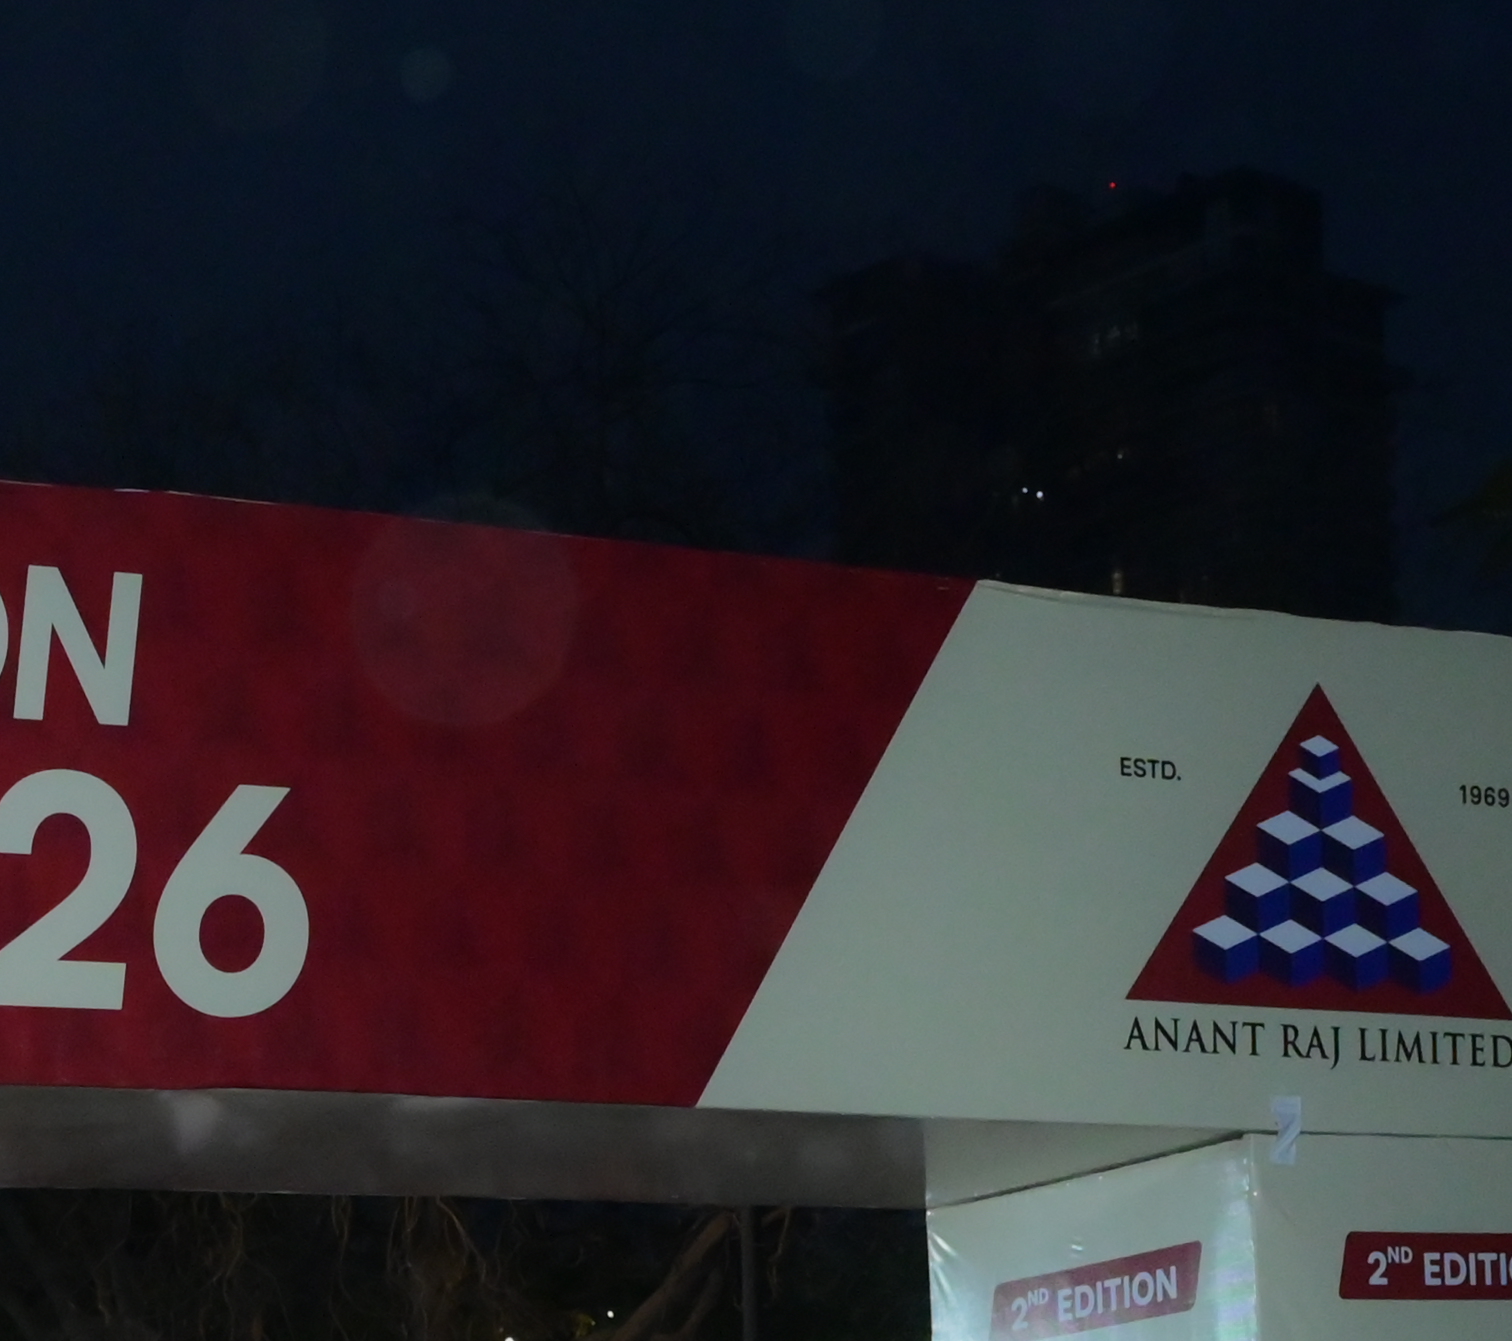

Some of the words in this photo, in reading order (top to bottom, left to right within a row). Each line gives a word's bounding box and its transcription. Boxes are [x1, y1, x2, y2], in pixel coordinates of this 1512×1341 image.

[1120, 757, 1182, 782] ESTD.
[1458, 783, 1511, 809] 1969
[1123, 1017, 1266, 1059] ANANT
[1280, 1024, 1344, 1070] RAJ
[1367, 1246, 1414, 1288] 2ND
[1010, 1286, 1050, 1334] 2ND
[1057, 1266, 1178, 1324] EDITION
